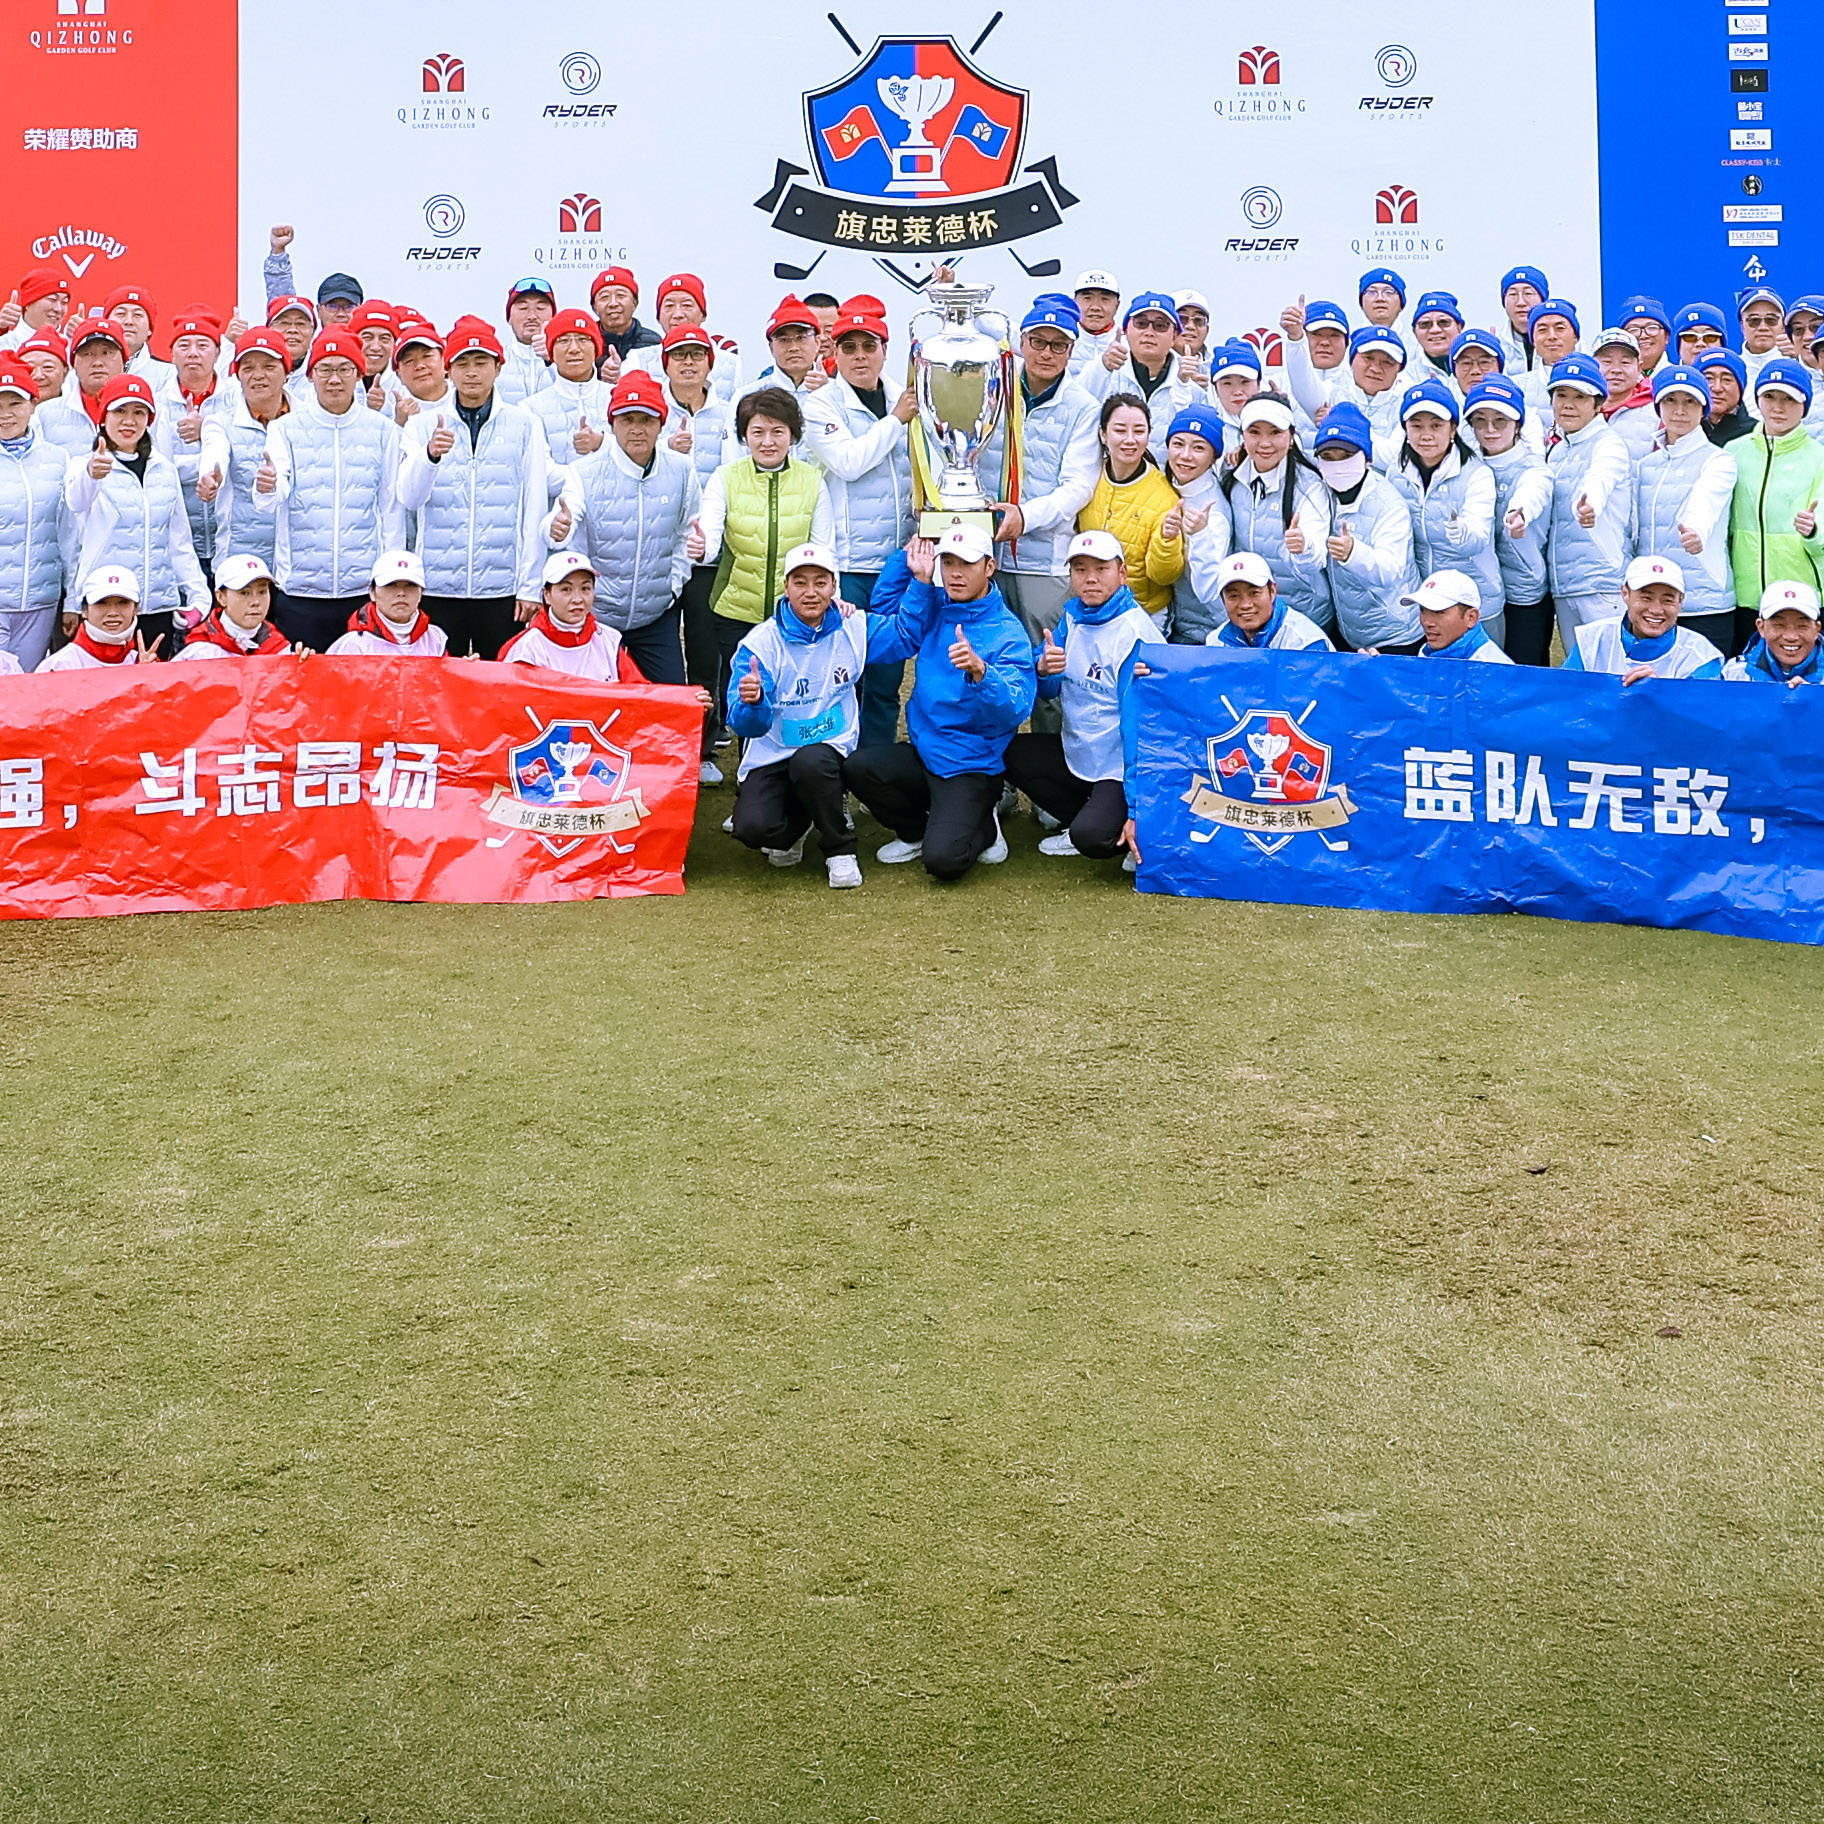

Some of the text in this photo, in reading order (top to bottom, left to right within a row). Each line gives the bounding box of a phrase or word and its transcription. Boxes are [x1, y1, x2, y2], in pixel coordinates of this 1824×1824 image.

[30, 29, 133, 49] QIZHONG
[46, 46, 117, 54] GARDEN GOLF CLUB
[542, 104, 618, 118] RYDER
[1214, 99, 1306, 116] QIZHONG
[1358, 97, 1434, 110] RYDER
[397, 107, 490, 123] QIZHONG
[554, 120, 606, 128] SPORTS
[23, 127, 139, 151] 荣耀赞助商
[834, 209, 999, 246] 旗忠莱德杯
[32, 224, 127, 260] Callaway
[1224, 238, 1300, 252] RYDER
[1351, 238, 1444, 255] QIZHONG
[406, 247, 482, 260] RYDER
[534, 247, 627, 264] QIZHONG
[520, 809, 606, 831] 旗忠莱德杯
[1224, 803, 1314, 827] 旗忠莱德杯
